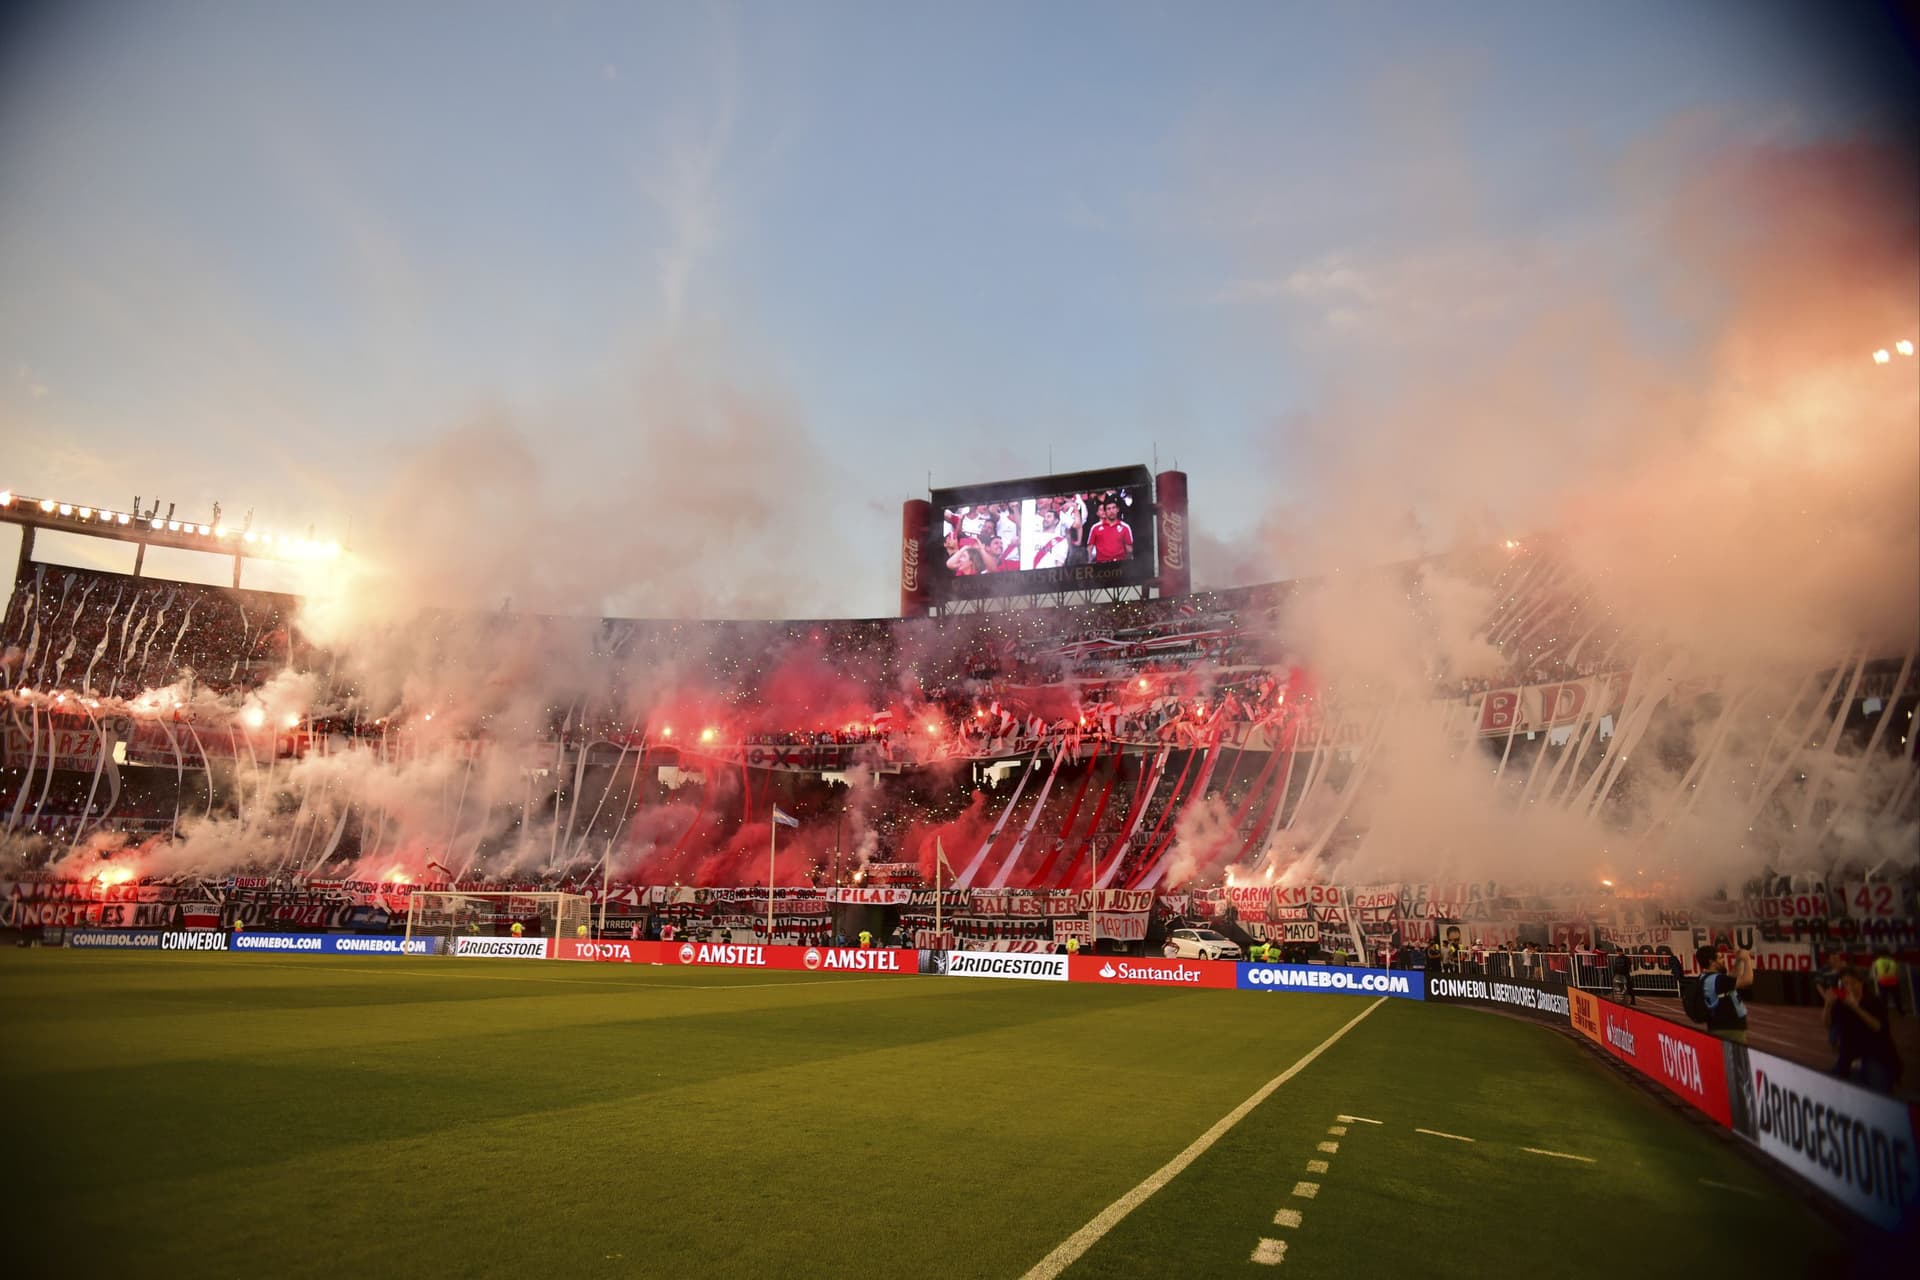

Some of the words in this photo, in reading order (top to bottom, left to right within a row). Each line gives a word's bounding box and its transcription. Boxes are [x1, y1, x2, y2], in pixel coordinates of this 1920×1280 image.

[234, 877, 268, 888] FAUSTO
[343, 880, 378, 894] LOCURA
[380, 882, 394, 895] SIN
[580, 886, 650, 905] OZZY
[841, 889, 895, 903] PILAR
[1080, 891, 1105, 910] SAN
[1108, 891, 1151, 911] JUSTO
[1276, 889, 1308, 905] KM
[1310, 886, 1339, 904] 30
[101, 905, 126, 926] ES
[976, 898, 1077, 915] BALLESTER
[73, 933, 159, 946] CONMEBOL.COM
[162, 932, 228, 950] CONMEBOL
[1252, 925, 1267, 939] LA
[1267, 924, 1284, 940] DE
[1284, 925, 1316, 940] MAYO
[236, 936, 322, 950] CONMEBOL.COM
[335, 938, 427, 953] CONMEBOL.COM
[458, 939, 545, 957] BRIDGESTONE
[575, 943, 632, 959] TOYOTA
[697, 944, 766, 966] AMSTEL
[823, 948, 900, 971] AMSTEL
[950, 955, 1066, 977] BRIDGESTONE
[1118, 962, 1201, 983] Santander
[1247, 968, 1410, 994] CONMEBOL.COM
[1430, 978, 1489, 999] CONMEBOL
[1489, 982, 1536, 1008] LIBERTADORES
[1657, 1032, 1704, 1095] TOYOTA
[1756, 1070, 1913, 1207] BRIDGESTONE
